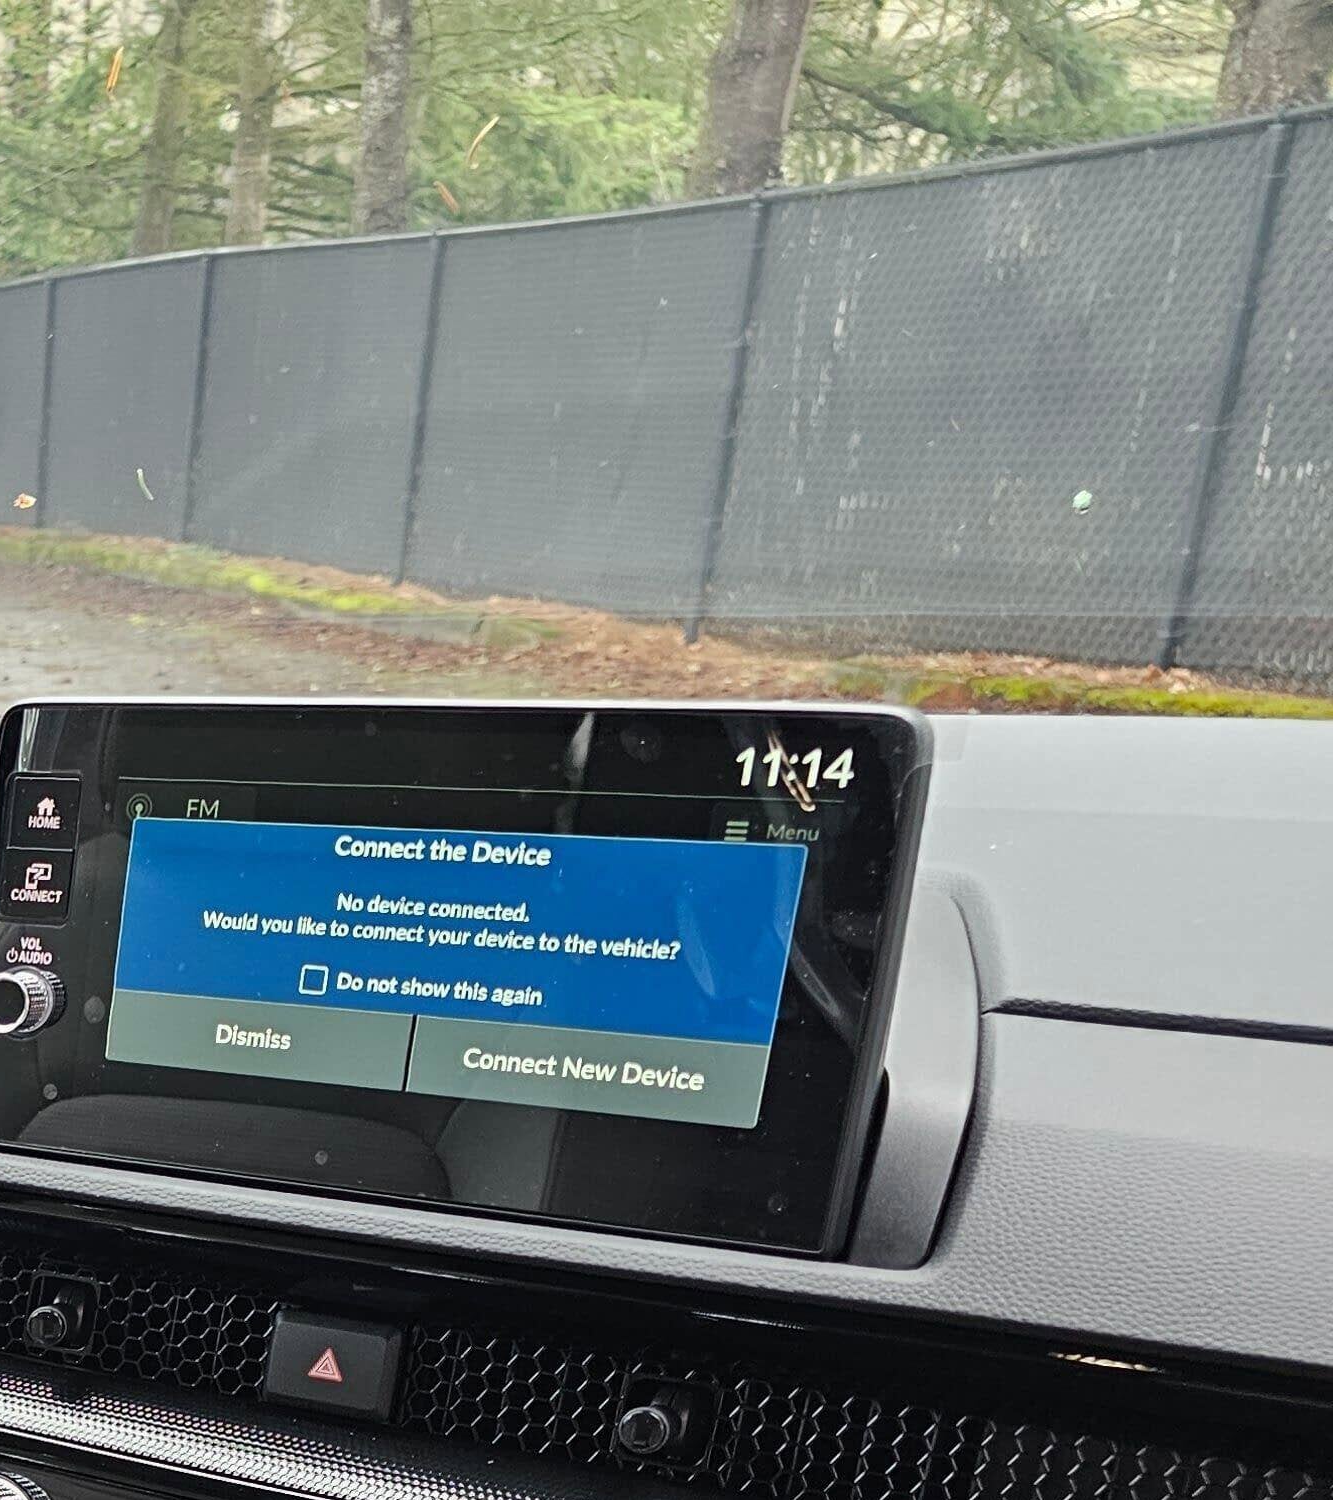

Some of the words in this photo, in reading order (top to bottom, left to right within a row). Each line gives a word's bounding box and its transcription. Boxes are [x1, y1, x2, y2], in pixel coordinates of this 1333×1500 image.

[735, 746, 855, 789] 11:14
[27, 815, 62, 829] HOME
[186, 798, 220, 819] FM
[766, 823, 821, 841] Menu
[334, 834, 426, 861] Connect
[429, 838, 468, 862] the
[471, 840, 552, 867] Device
[10, 888, 63, 904] CONNECT
[336, 892, 364, 913] No
[366, 894, 426, 917] device
[428, 902, 531, 923] connected.
[20, 936, 43, 951] VOL
[203, 910, 259, 932] Would
[261, 916, 293, 935] you
[296, 915, 327, 936] like
[330, 919, 350, 938] to
[352, 925, 425, 943] connect
[428, 927, 472, 947] your
[473, 927, 535, 951] device
[538, 931, 561, 952] to
[564, 933, 598, 955] the
[601, 937, 682, 960] vehicle?
[17, 950, 53, 966] AUDIO
[336, 971, 364, 992] Do
[366, 976, 398, 994] not
[400, 977, 451, 999] show
[453, 979, 488, 1002] this
[490, 986, 543, 1007] again
[215, 1023, 292, 1050] Dismiss
[462, 1047, 558, 1076] Connect
[561, 1056, 617, 1082] New
[620, 1061, 706, 1091] Device
